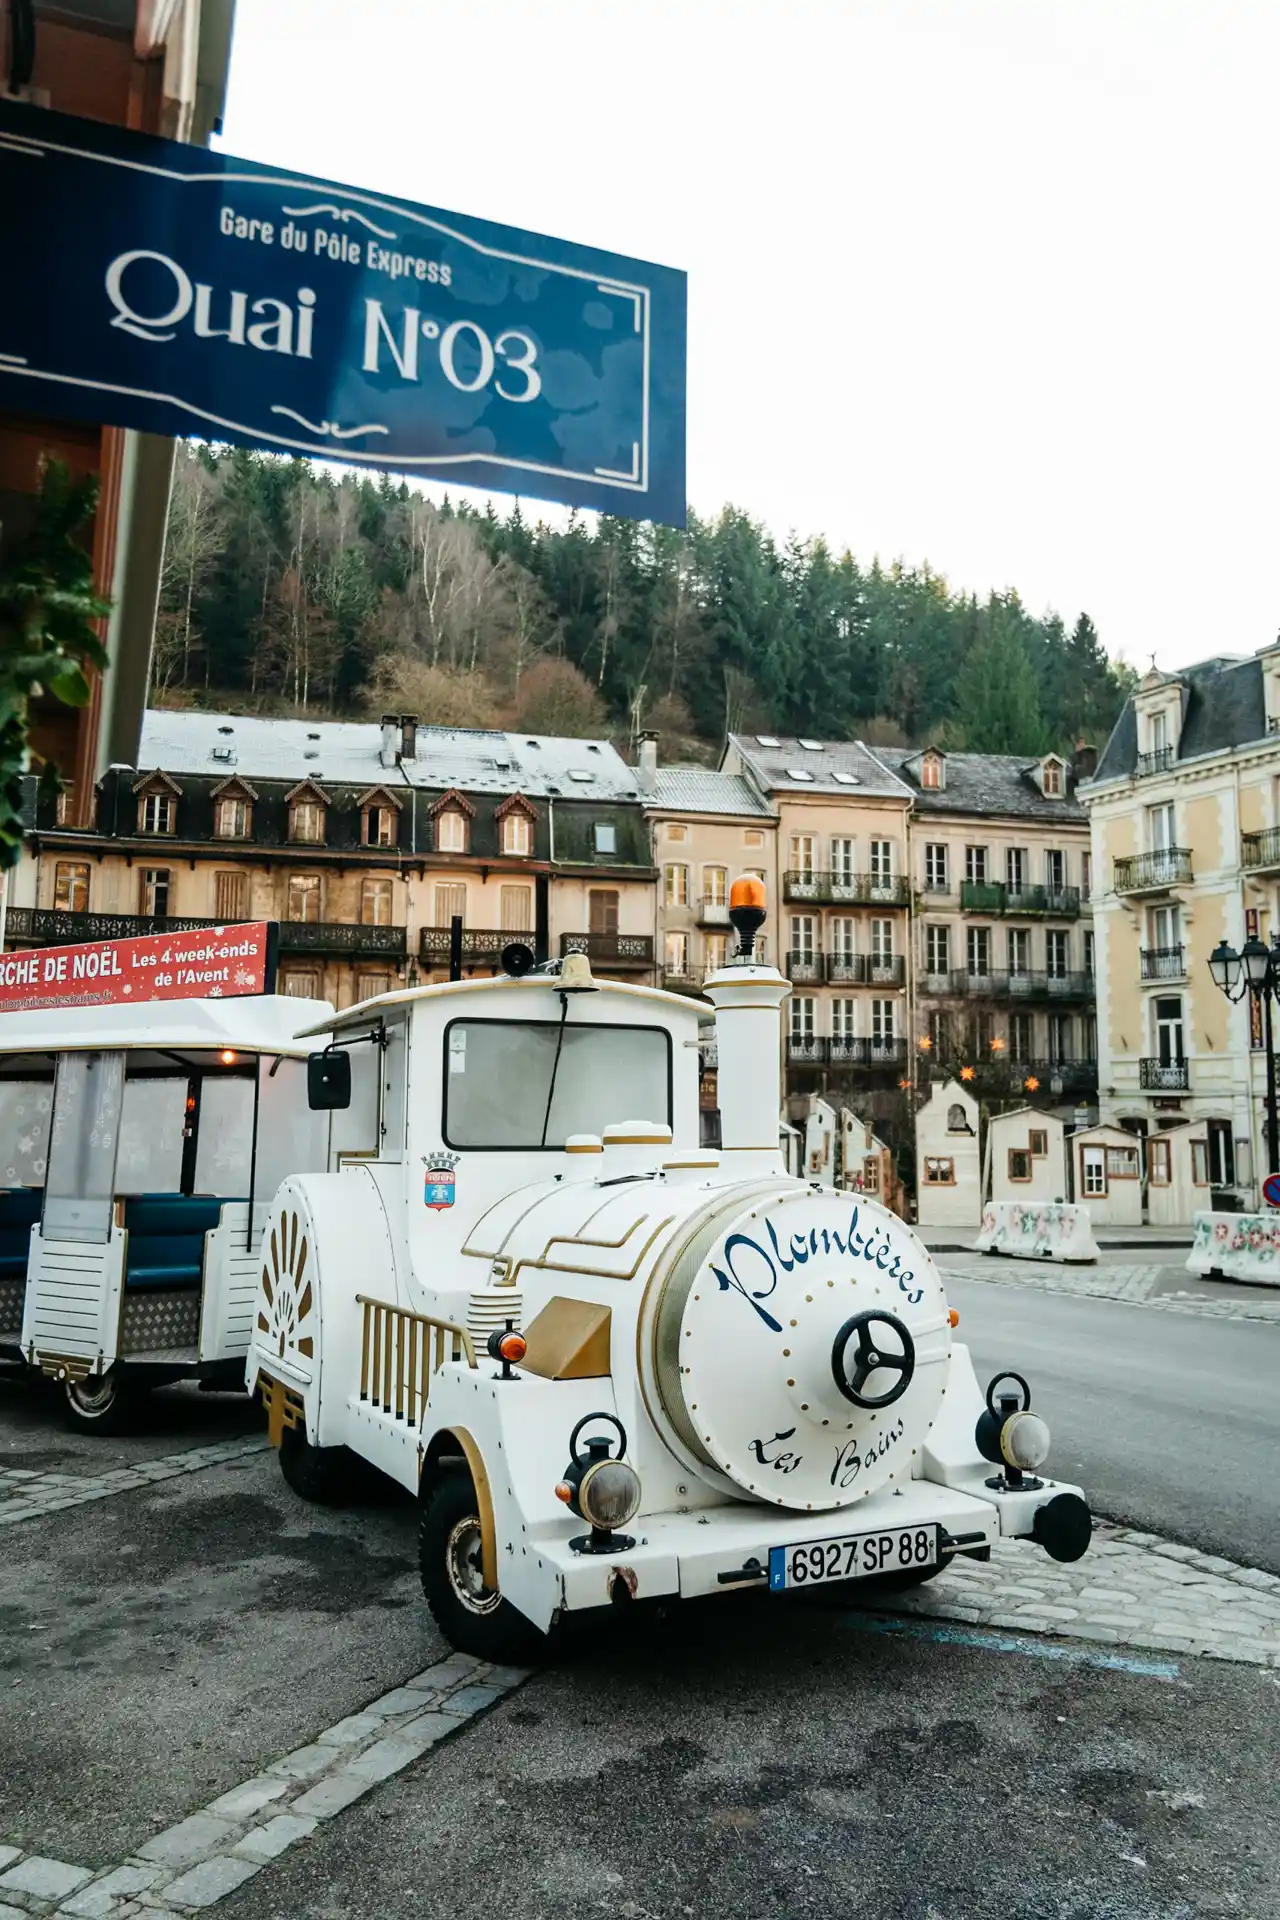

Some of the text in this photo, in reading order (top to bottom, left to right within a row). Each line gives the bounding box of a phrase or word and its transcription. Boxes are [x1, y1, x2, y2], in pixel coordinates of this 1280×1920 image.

[220, 207, 452, 287] Gare du Pôle Express
[105, 249, 542, 402] Quai N°03
[44, 956, 68, 982] DE
[73, 946, 122, 979] NOËL
[132, 940, 258, 968] Les 4 week-ends
[155, 966, 229, 987] de l'Avent
[711, 1206, 924, 1333] Plombières
[748, 1417, 904, 1488] Les Bains
[792, 1530, 929, 1583] 6927 SP 88
